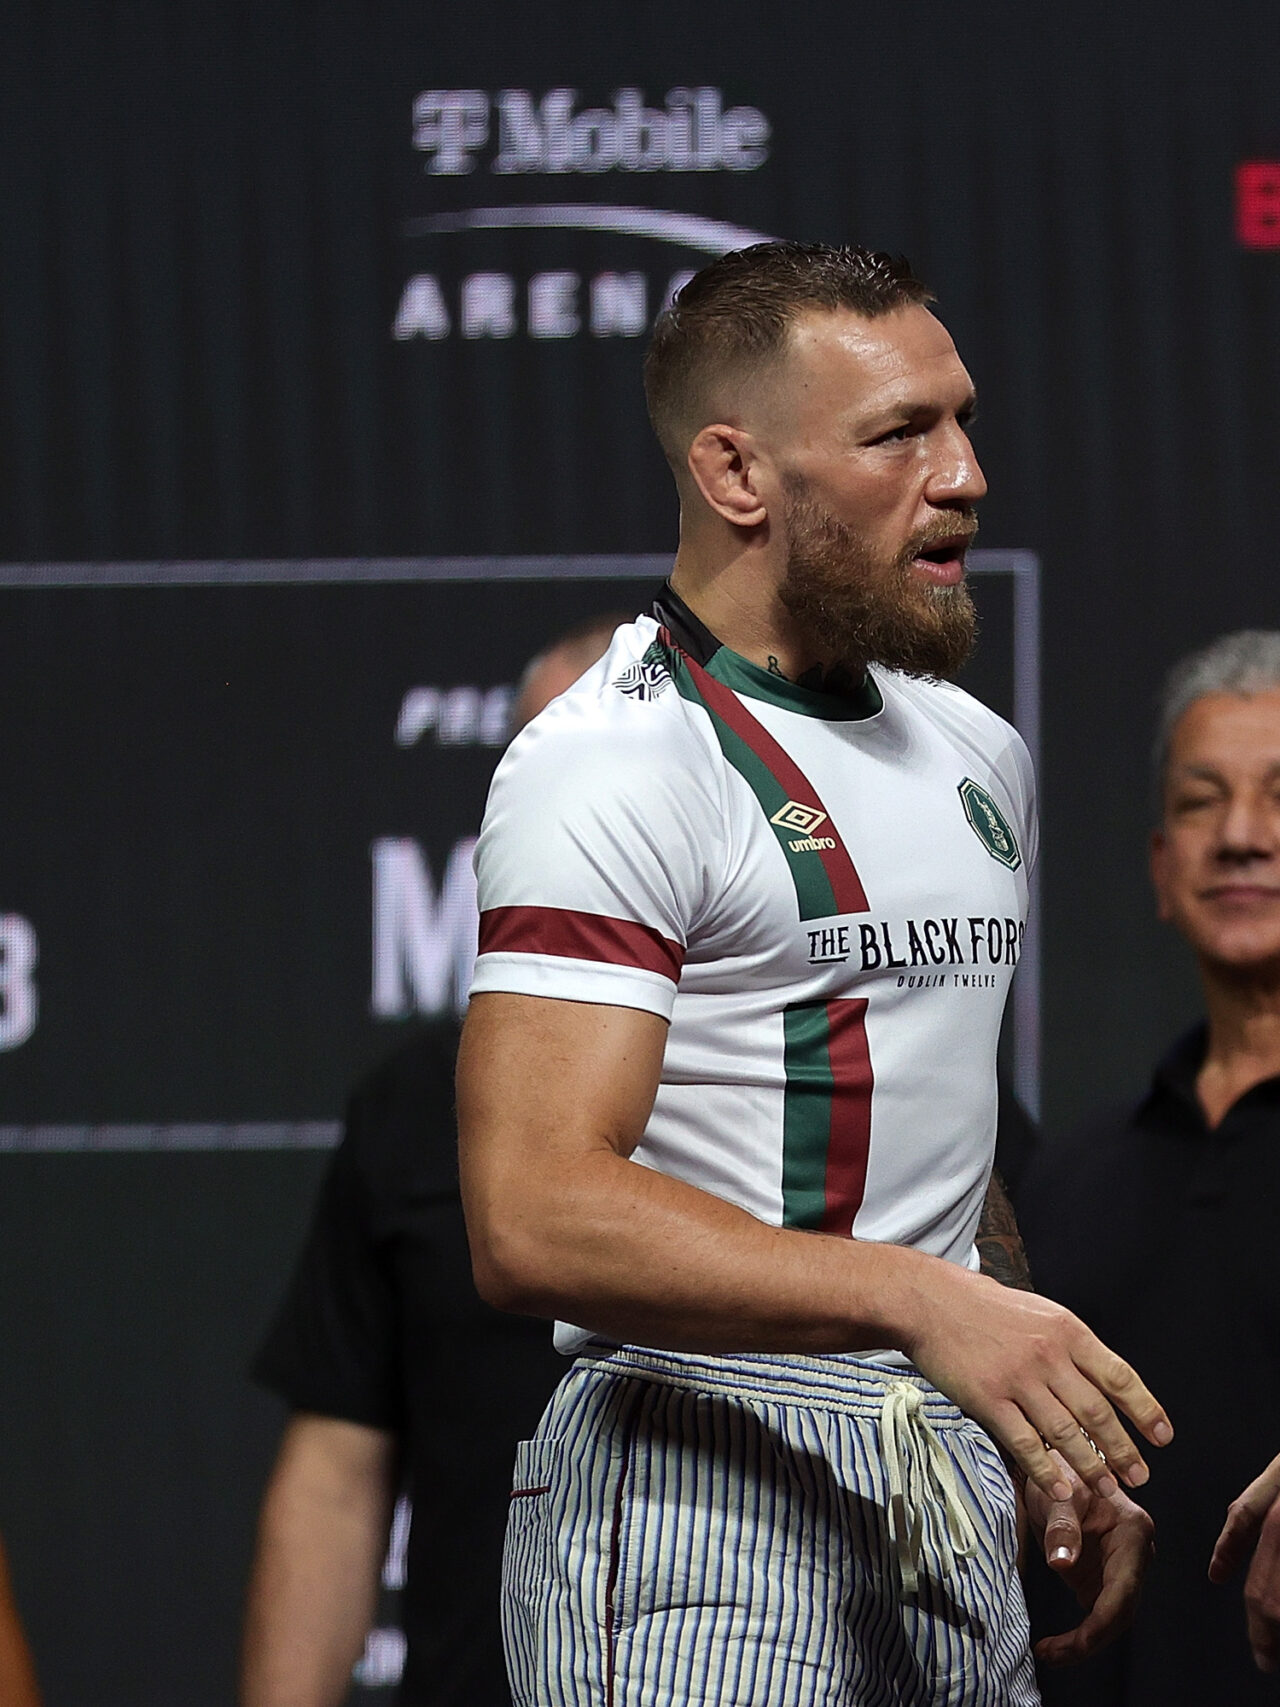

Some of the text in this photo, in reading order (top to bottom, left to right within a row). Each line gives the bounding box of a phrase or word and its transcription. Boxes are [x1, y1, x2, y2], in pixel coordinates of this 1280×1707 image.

[787, 834, 837, 853] umbro
[807, 926, 850, 958] THE
[858, 918, 964, 971] BLACK
[897, 974, 996, 988] DUBLIN TWELVE
